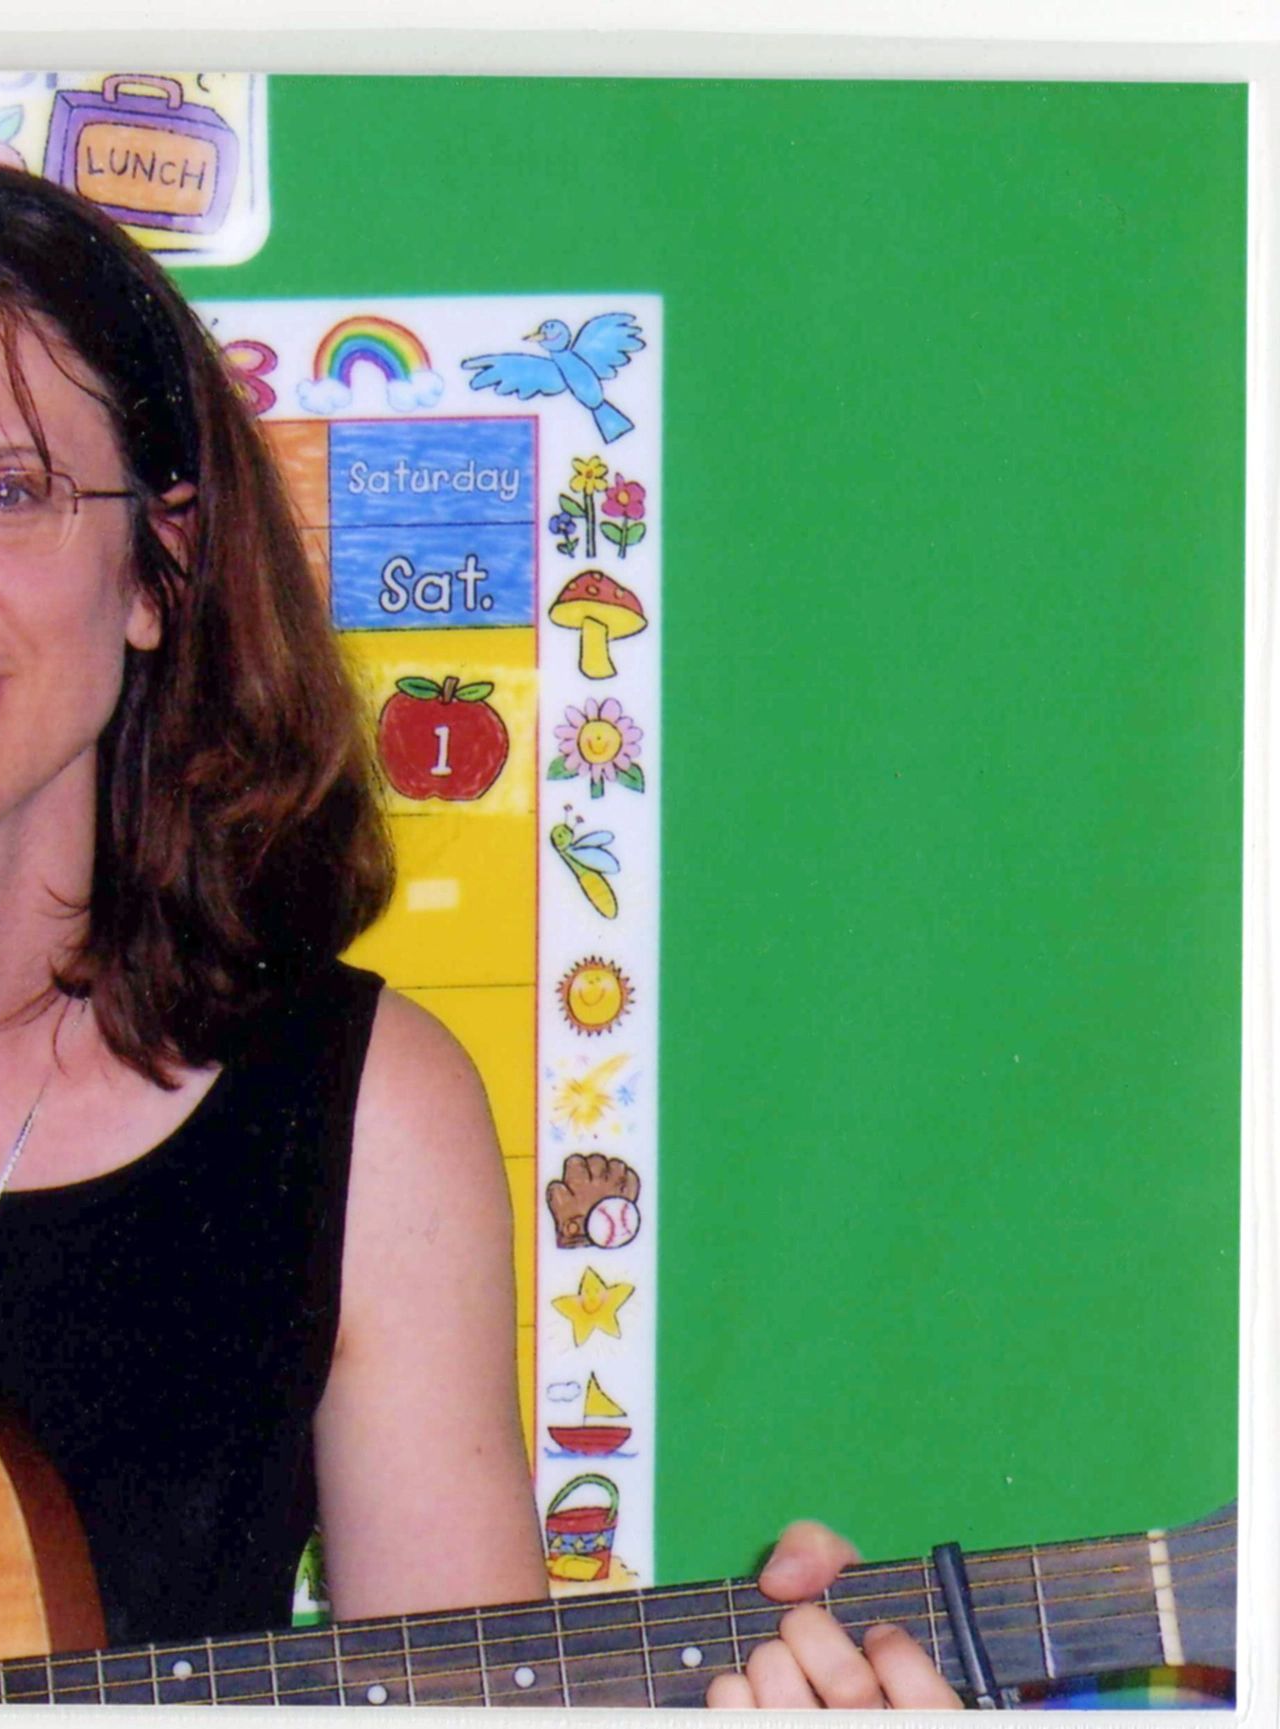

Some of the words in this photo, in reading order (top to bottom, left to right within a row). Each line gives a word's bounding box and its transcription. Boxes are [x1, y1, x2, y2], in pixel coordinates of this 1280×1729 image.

[85, 147, 206, 191] LUNCH
[348, 460, 520, 502] Saturday
[378, 554, 495, 614] Sat.
[429, 725, 453, 777] 1
